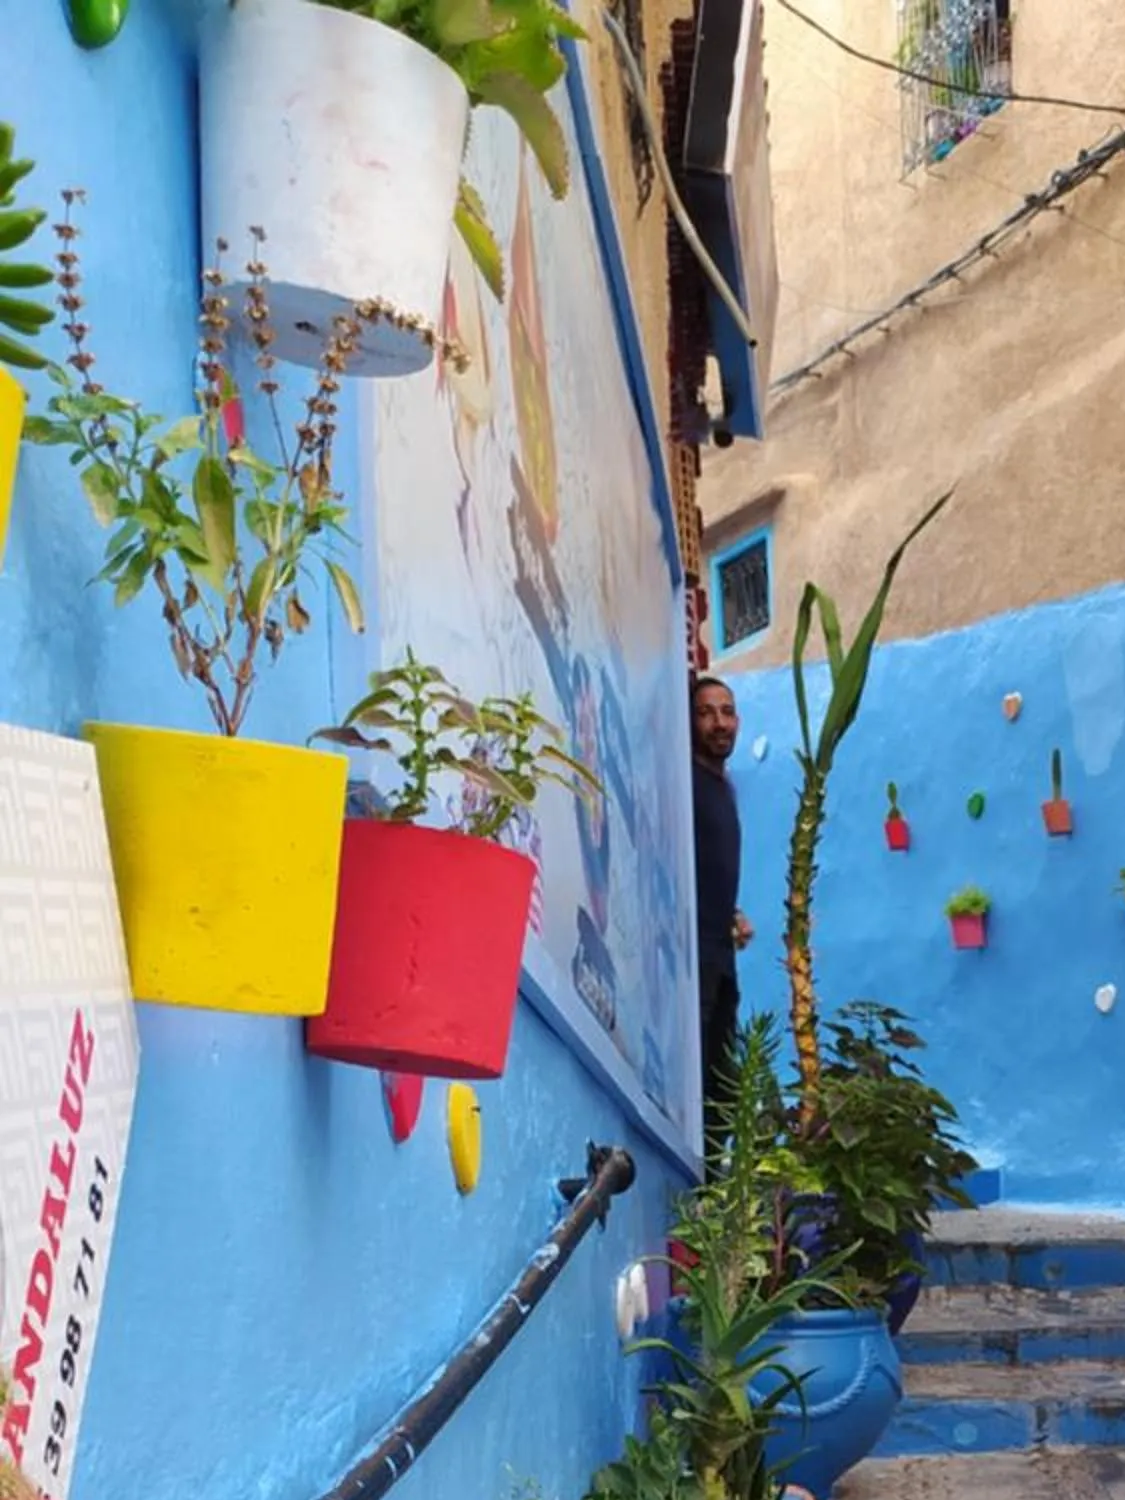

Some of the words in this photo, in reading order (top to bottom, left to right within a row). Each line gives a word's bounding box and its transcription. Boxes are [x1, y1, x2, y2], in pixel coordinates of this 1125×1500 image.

[2, 1007, 95, 1466] ANDALUZ
[43, 1400, 67, 1477] 39
[60, 1314, 82, 1388] 98
[73, 1238, 95, 1297] 71
[88, 1155, 108, 1223] 81
